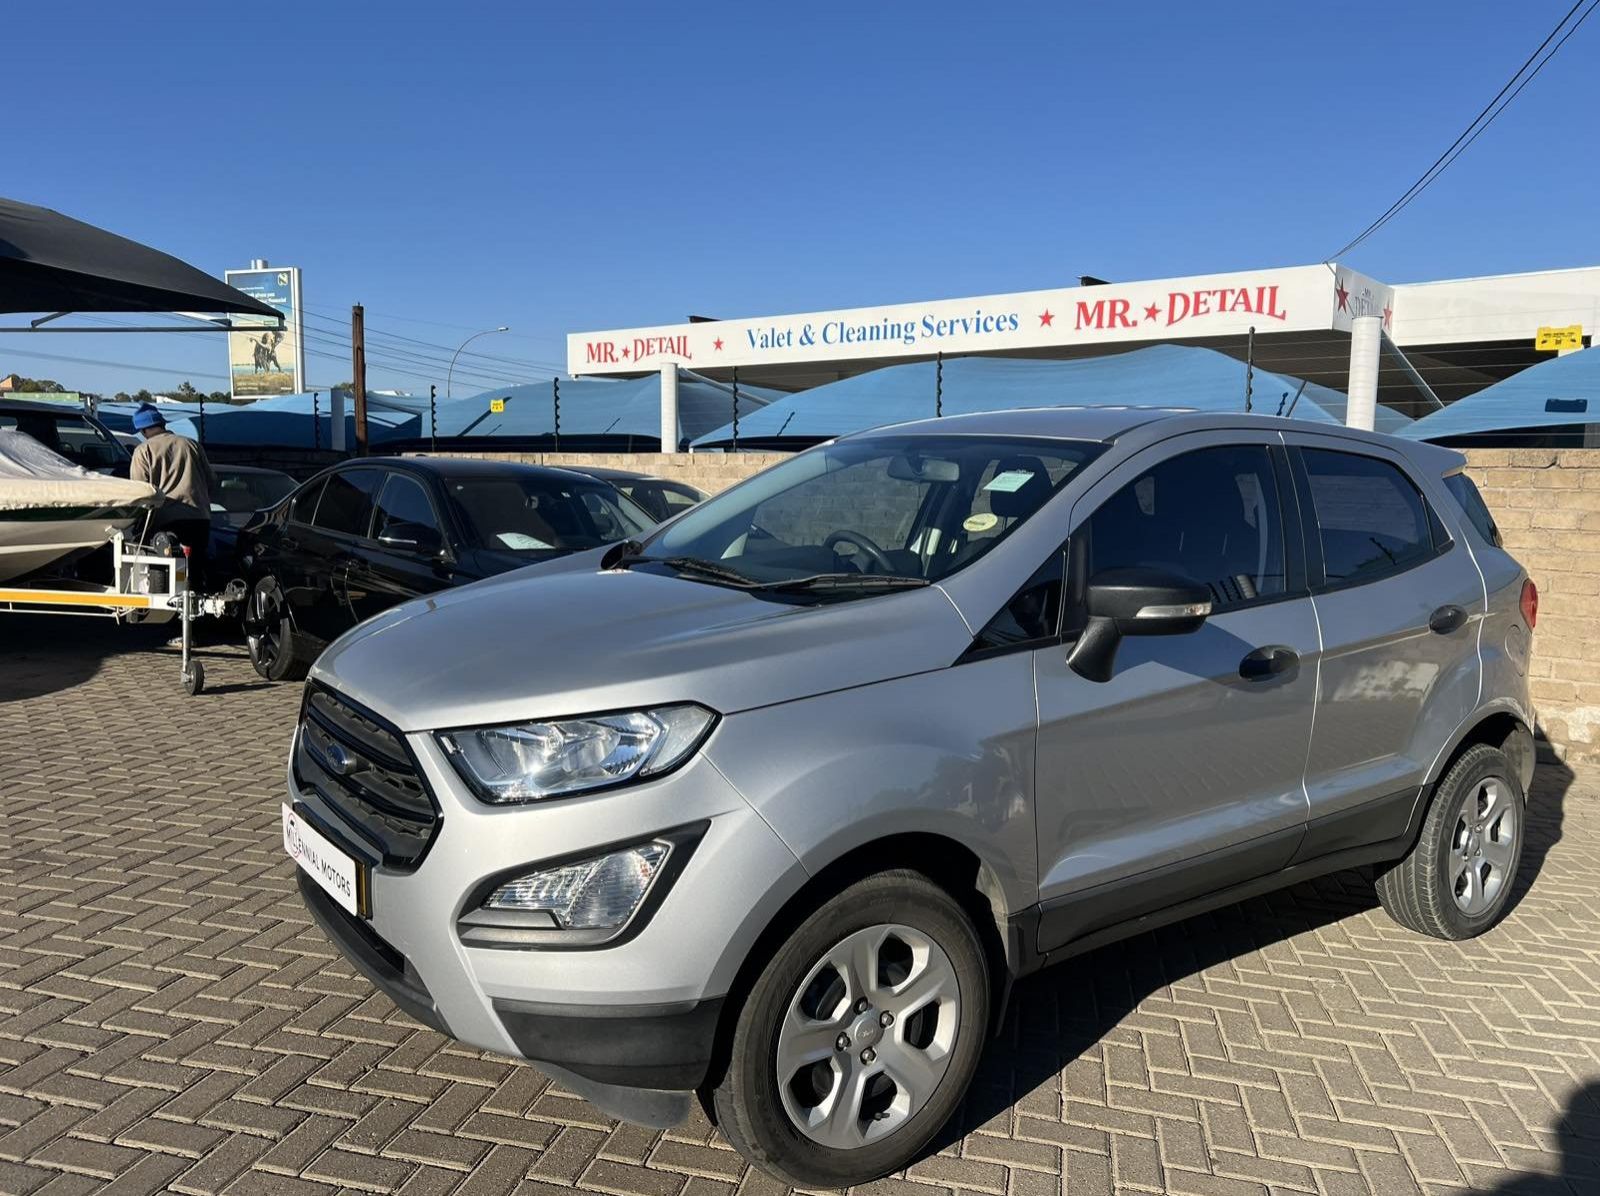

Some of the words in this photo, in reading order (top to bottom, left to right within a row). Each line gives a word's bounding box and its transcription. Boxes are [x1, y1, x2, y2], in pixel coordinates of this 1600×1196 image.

[1074, 299, 1138, 330] MR.
[1166, 285, 1286, 327] DETAIL
[747, 327, 793, 349] Valet
[799, 323, 815, 346] &
[822, 317, 916, 345] Cleaning
[921, 309, 1018, 338] Services
[586, 341, 619, 363] MR.
[633, 335, 692, 363] DETAIL
[321, 858, 351, 897] MOTORS
